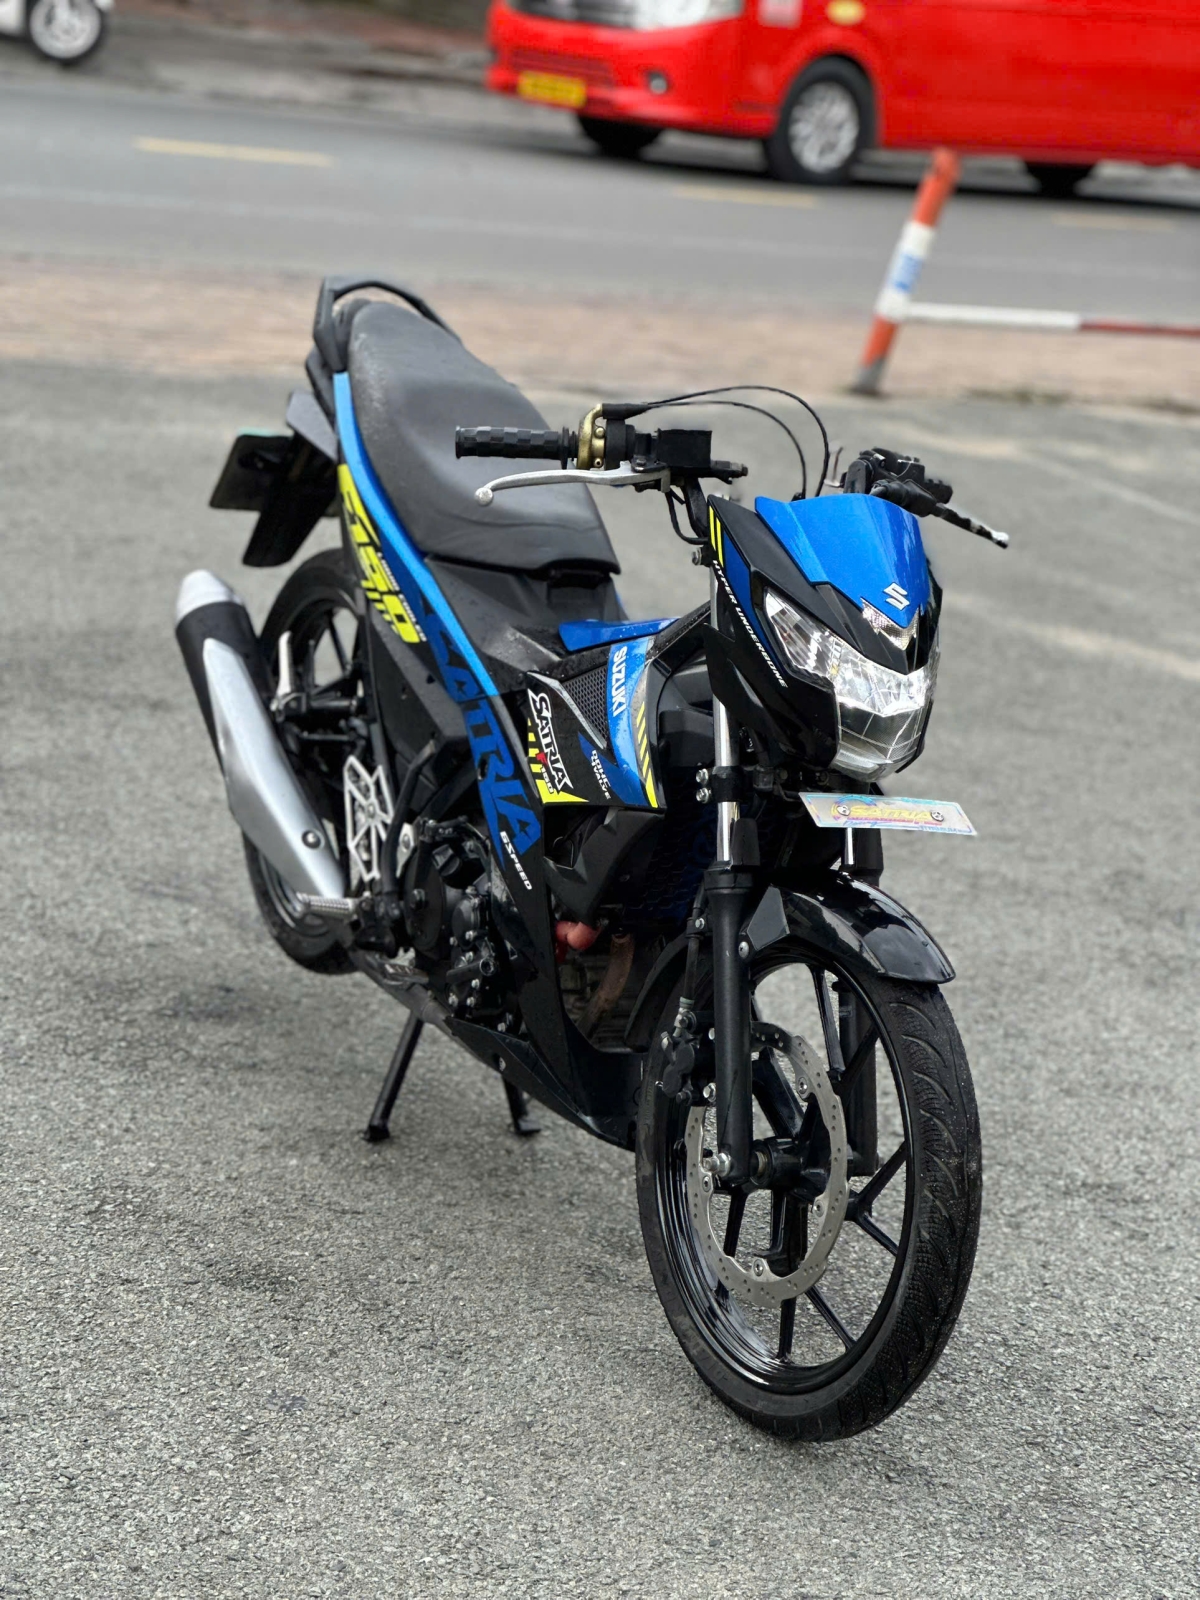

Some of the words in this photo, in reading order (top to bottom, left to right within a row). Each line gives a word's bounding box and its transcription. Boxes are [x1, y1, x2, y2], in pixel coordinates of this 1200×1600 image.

[712, 559, 738, 607] HYPER
[736, 606, 788, 689] UNDERBONE
[402, 578, 541, 868] SATRIA
[612, 646, 628, 717] SUZUKI
[528, 688, 574, 791] SATRIA
[849, 805, 932, 820] SATRIA
